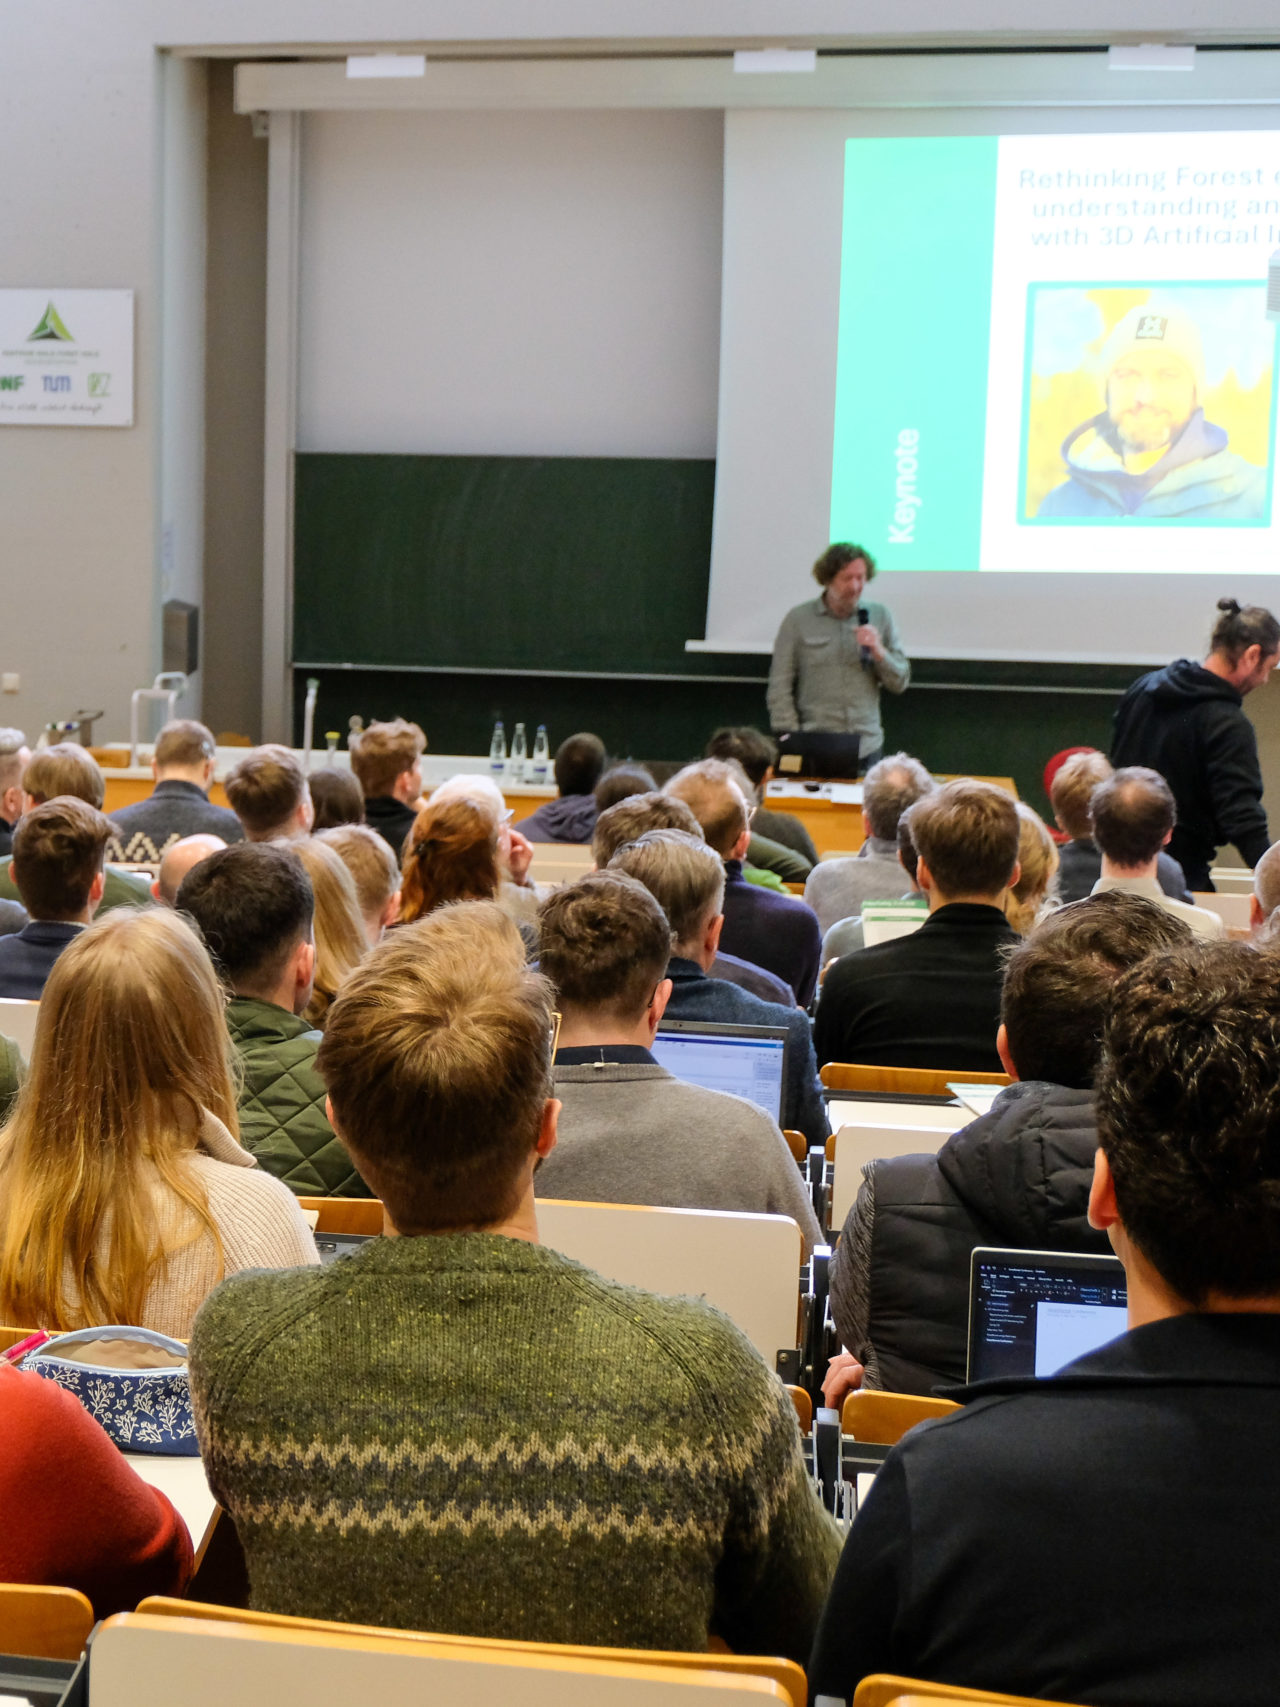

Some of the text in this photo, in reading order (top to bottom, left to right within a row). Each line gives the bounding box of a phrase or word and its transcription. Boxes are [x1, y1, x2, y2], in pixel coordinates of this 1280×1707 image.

[1019, 167, 1167, 192] Rethinking
[1176, 165, 1263, 187] Forest
[1032, 196, 1238, 220] understanding
[1031, 226, 1089, 246] with
[1099, 226, 1134, 246] 3D
[1144, 224, 1259, 245] Artificial
[887, 428, 923, 544] Keynote
